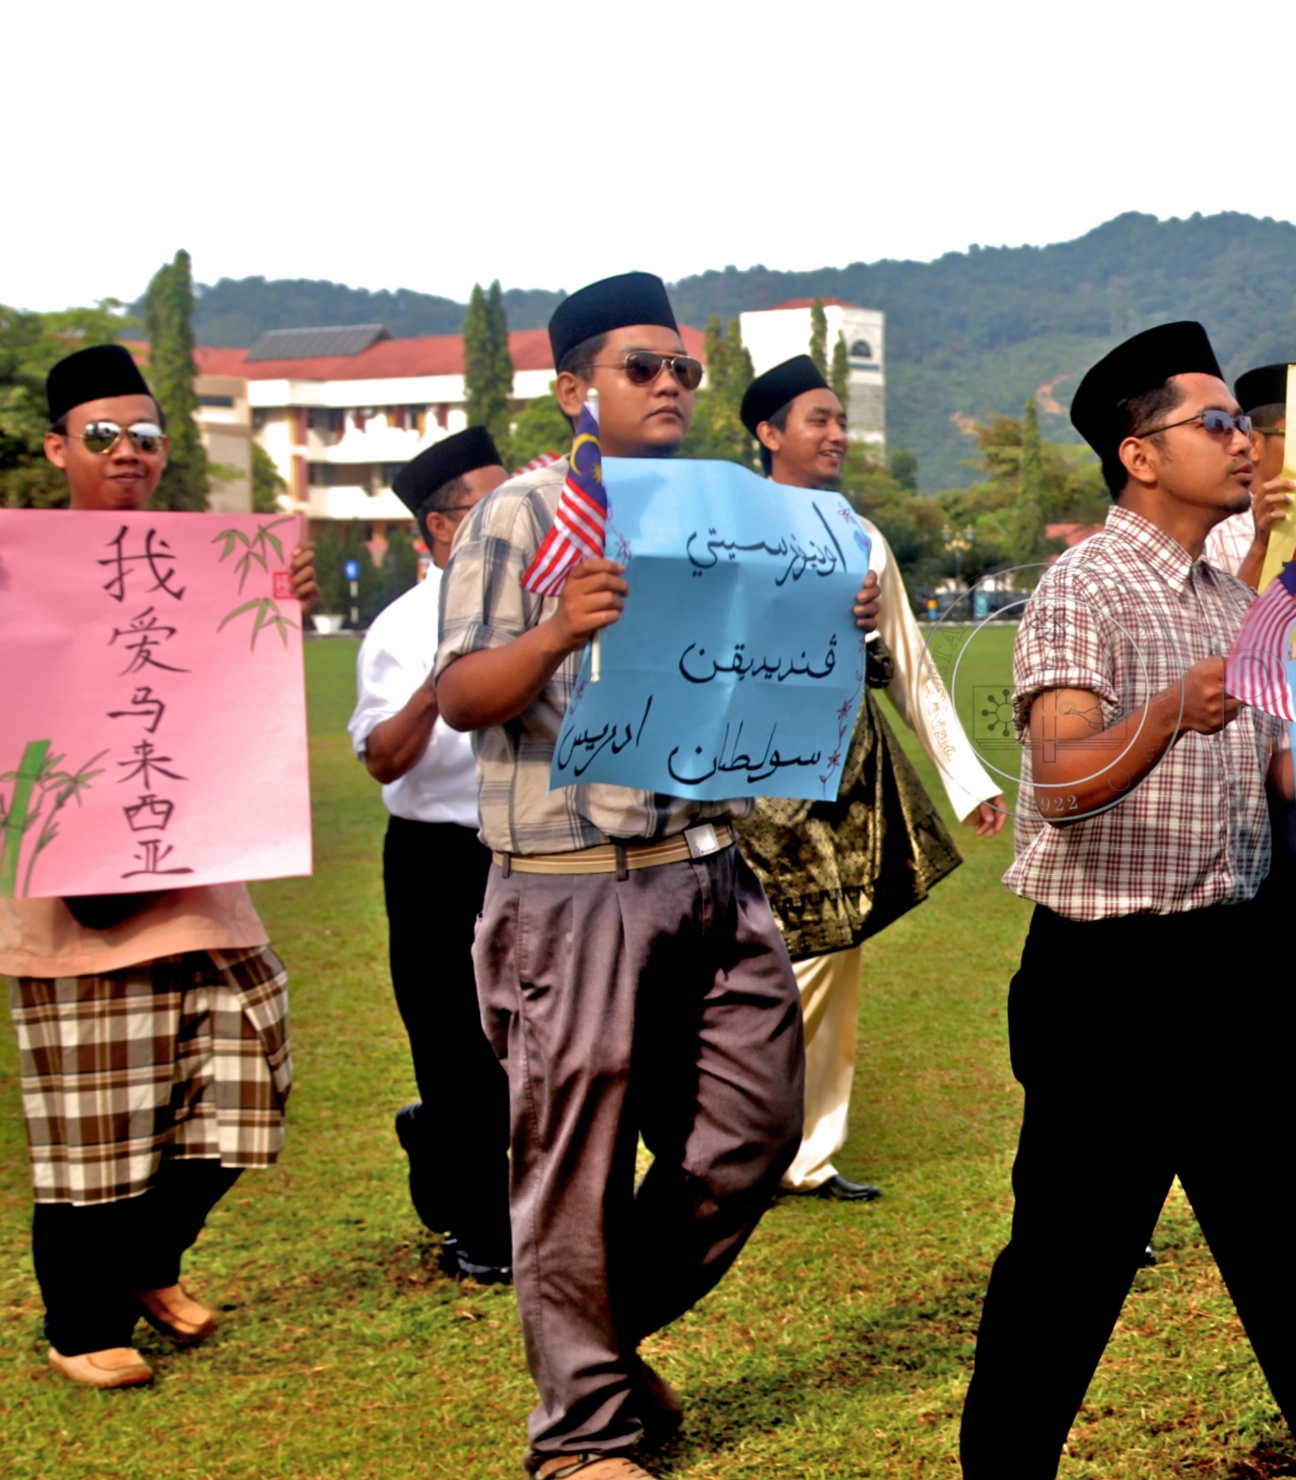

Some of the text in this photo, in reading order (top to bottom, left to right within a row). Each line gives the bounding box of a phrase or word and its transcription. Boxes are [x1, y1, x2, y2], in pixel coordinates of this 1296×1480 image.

[97, 524, 196, 880] 我爱马来西亚
